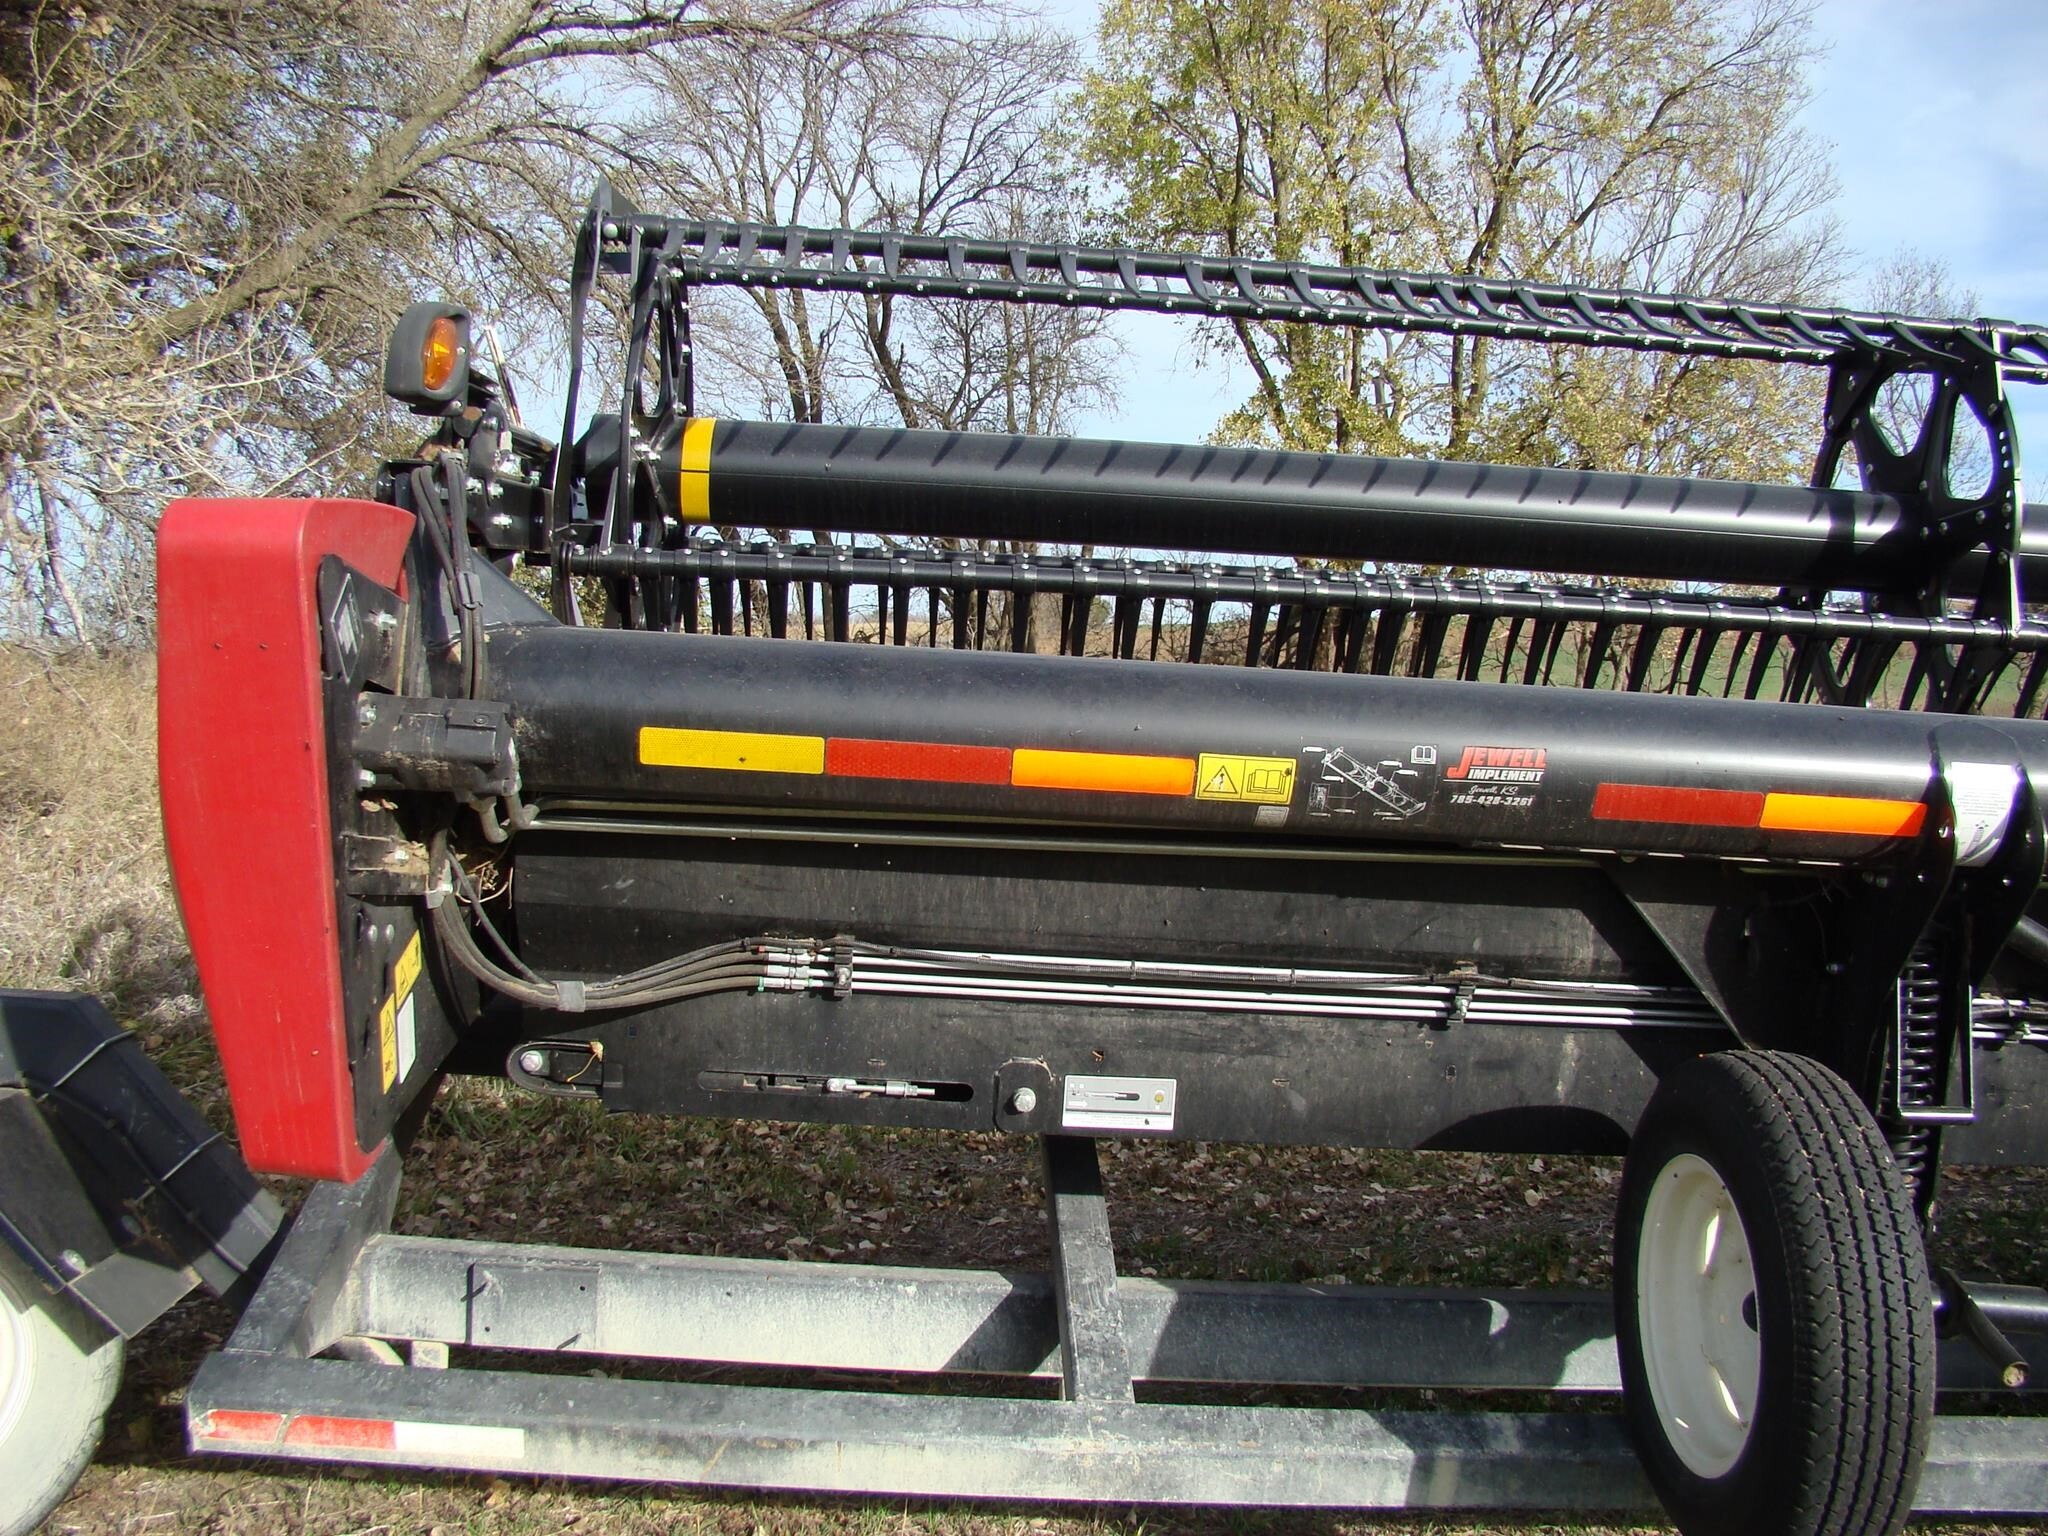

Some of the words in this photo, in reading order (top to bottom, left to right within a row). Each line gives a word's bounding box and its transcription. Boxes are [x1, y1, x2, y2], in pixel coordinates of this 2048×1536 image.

[1447, 746, 1546, 778] JEWELL
[1467, 769, 1544, 781] IMPLEMENT
[1500, 785, 1518, 795] KS
